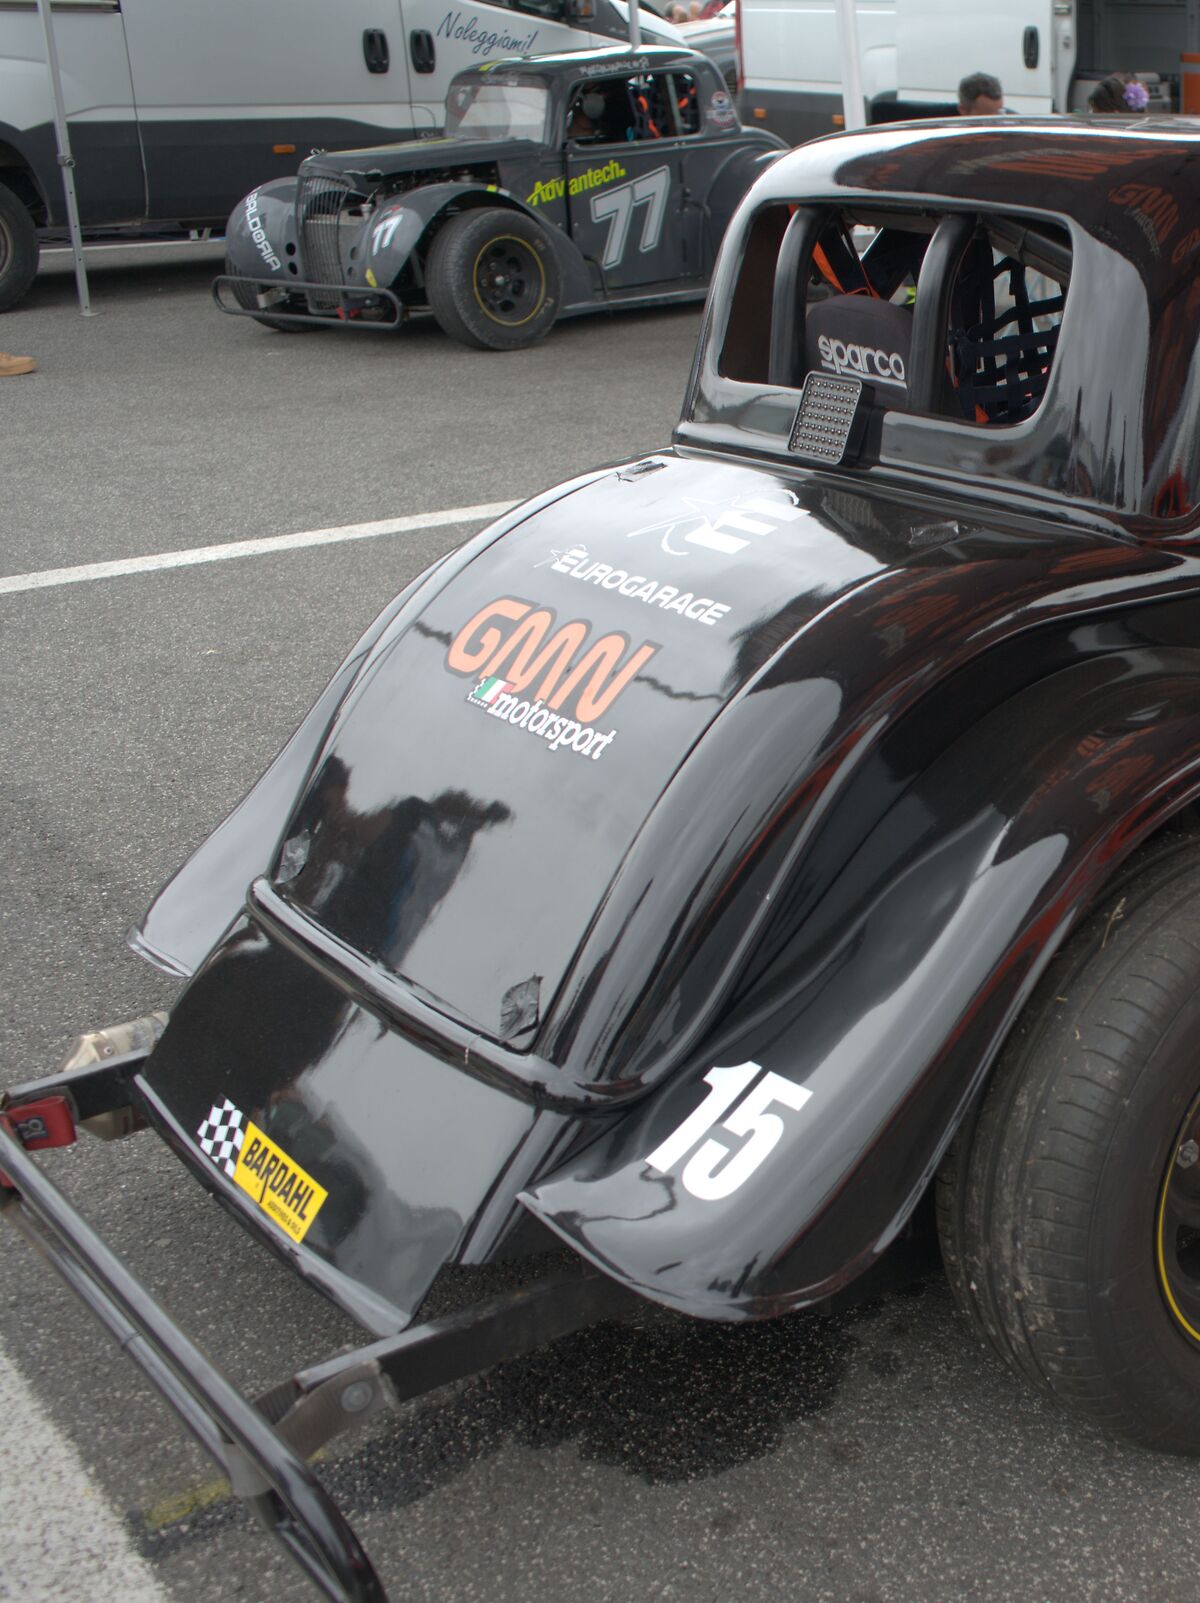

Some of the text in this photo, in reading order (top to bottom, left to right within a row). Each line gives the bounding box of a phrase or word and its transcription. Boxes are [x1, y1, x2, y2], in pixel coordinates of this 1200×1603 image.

[436, 11, 539, 56] Noleggiami!
[372, 214, 404, 256] 77
[590, 165, 671, 270] 77
[817, 334, 906, 380] sparco
[551, 549, 732, 625] EUROGARAGE
[487, 691, 618, 760] motorsport
[645, 1061, 813, 1200] 15
[242, 1137, 315, 1221] BARDAHL
